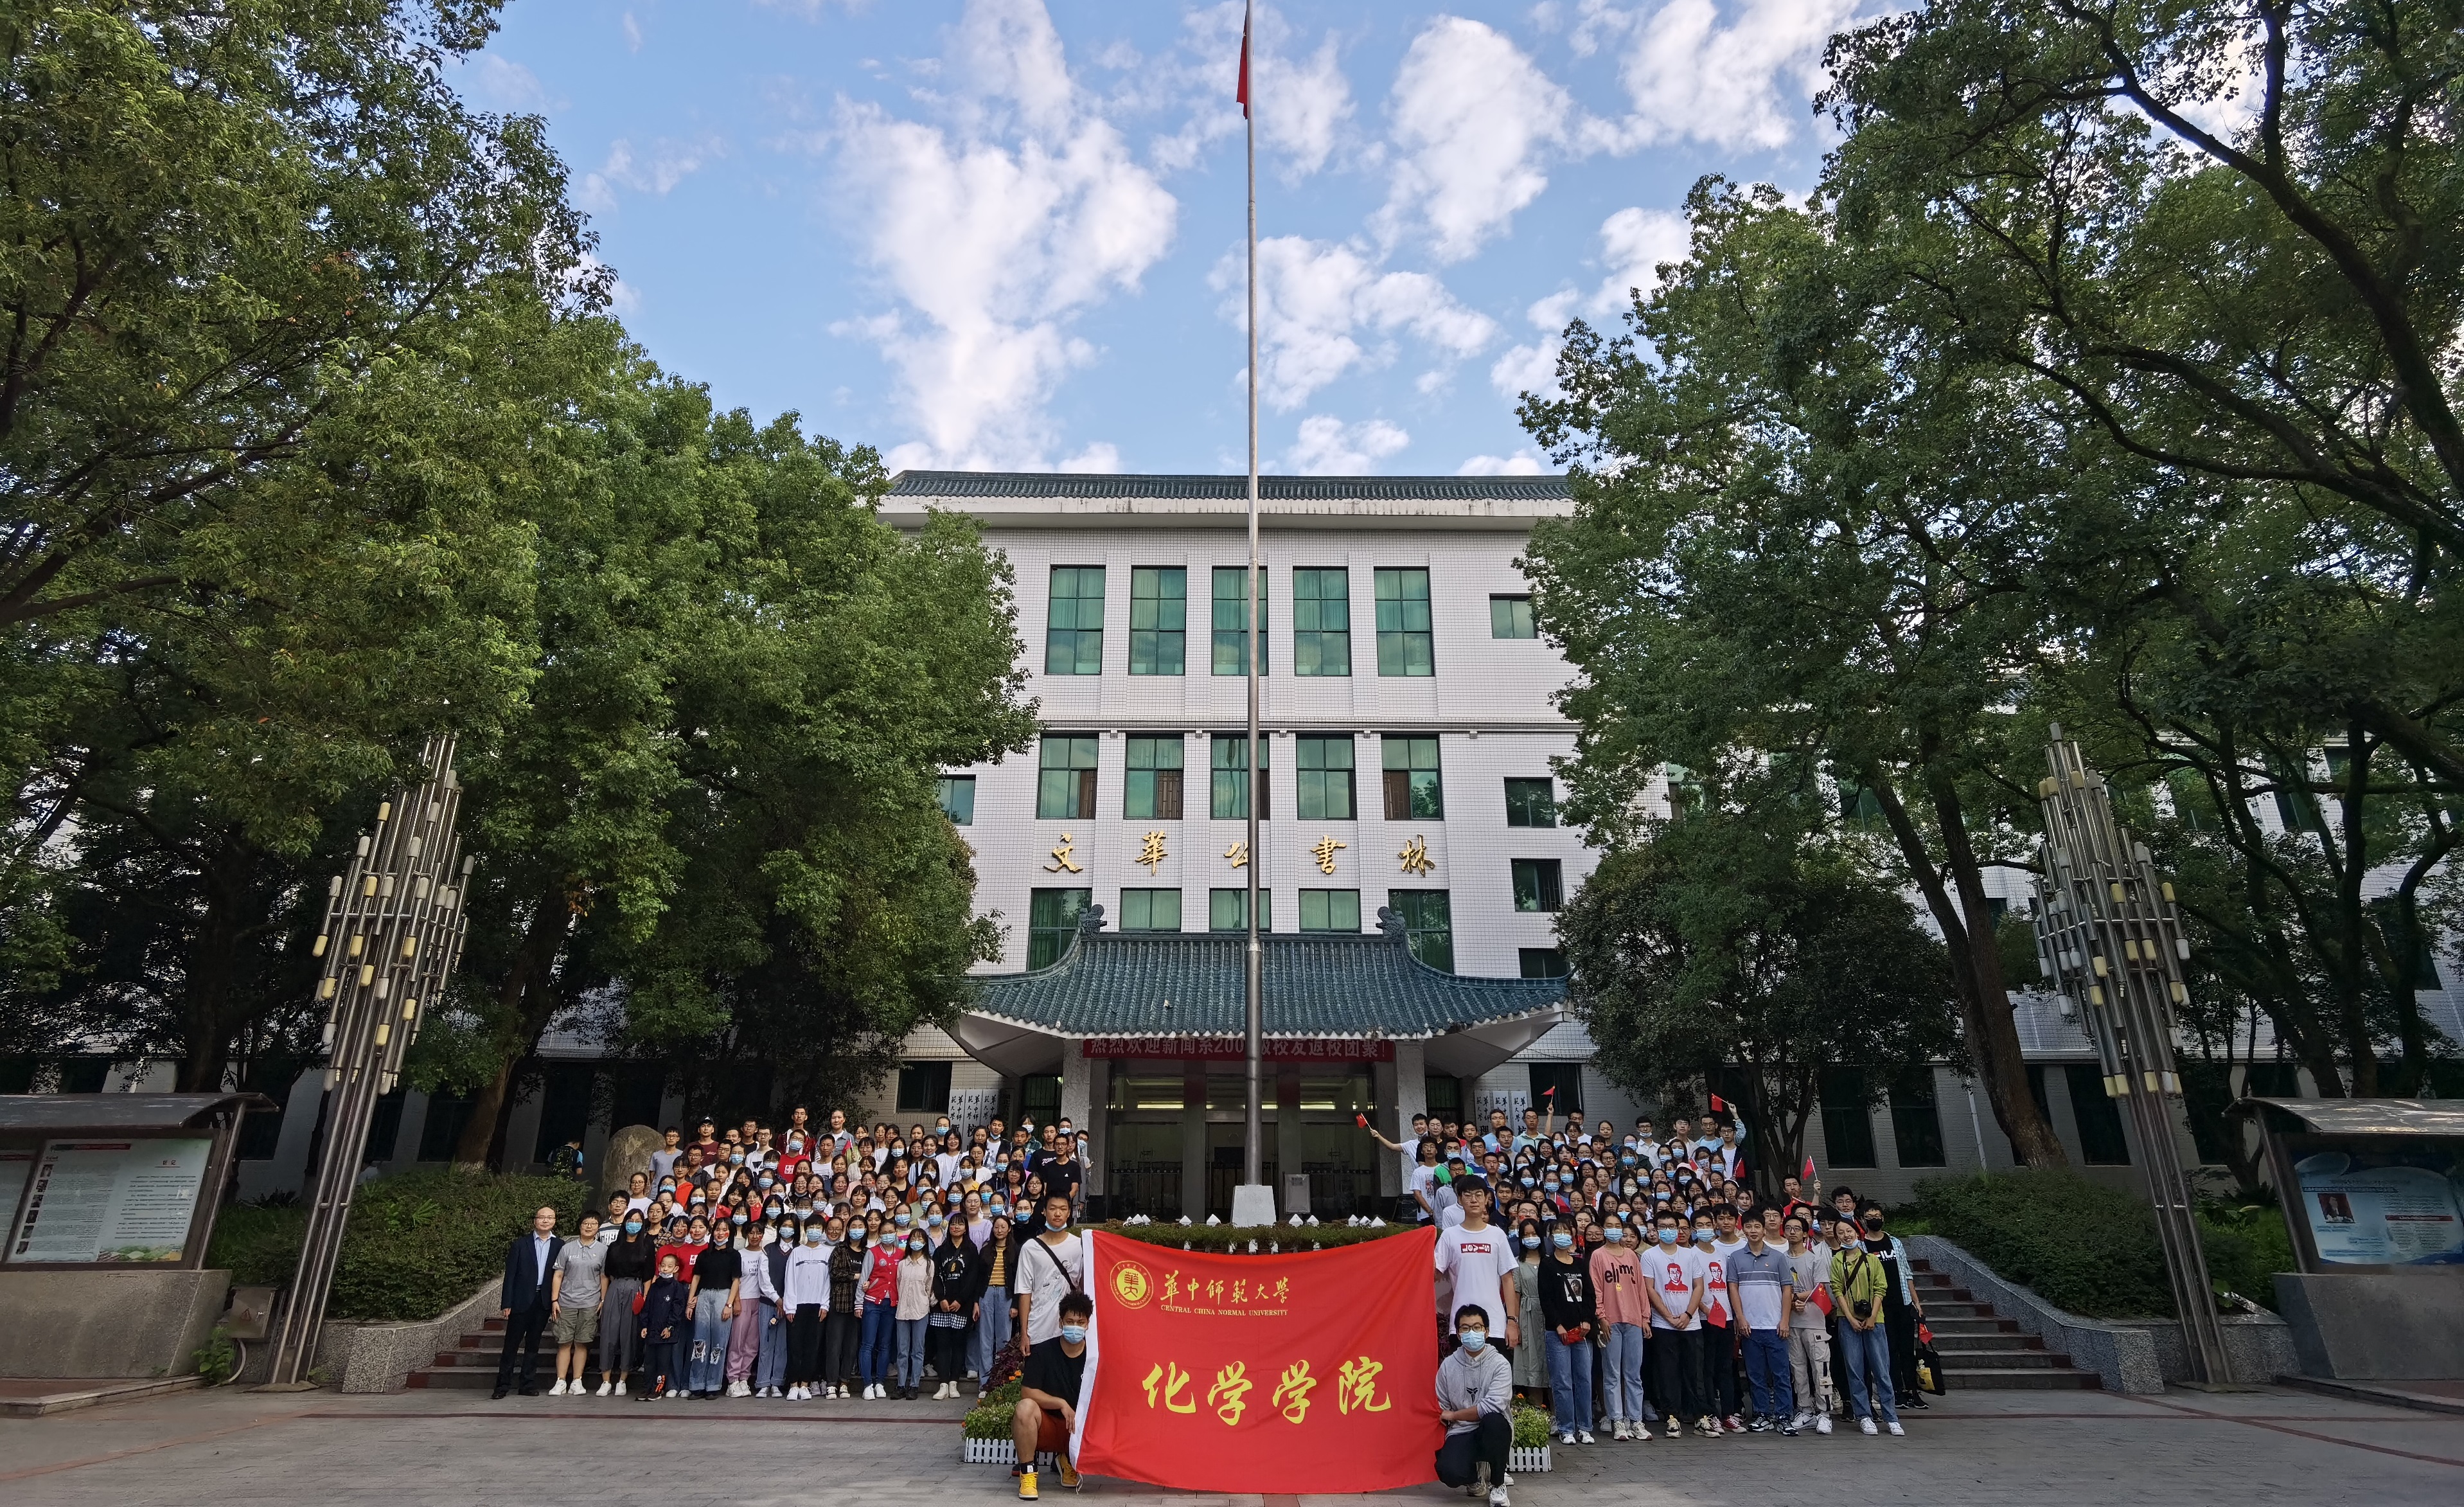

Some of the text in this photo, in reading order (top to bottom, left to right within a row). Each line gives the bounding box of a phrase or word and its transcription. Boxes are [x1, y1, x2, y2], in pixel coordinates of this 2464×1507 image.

[1090, 1038, 1385, 1057] 热烈欢迎新闻系200级校友返校团聚!
[1161, 1305, 1191, 1314] CENTRAL
[1142, 1356, 1392, 1426] 化学学院
